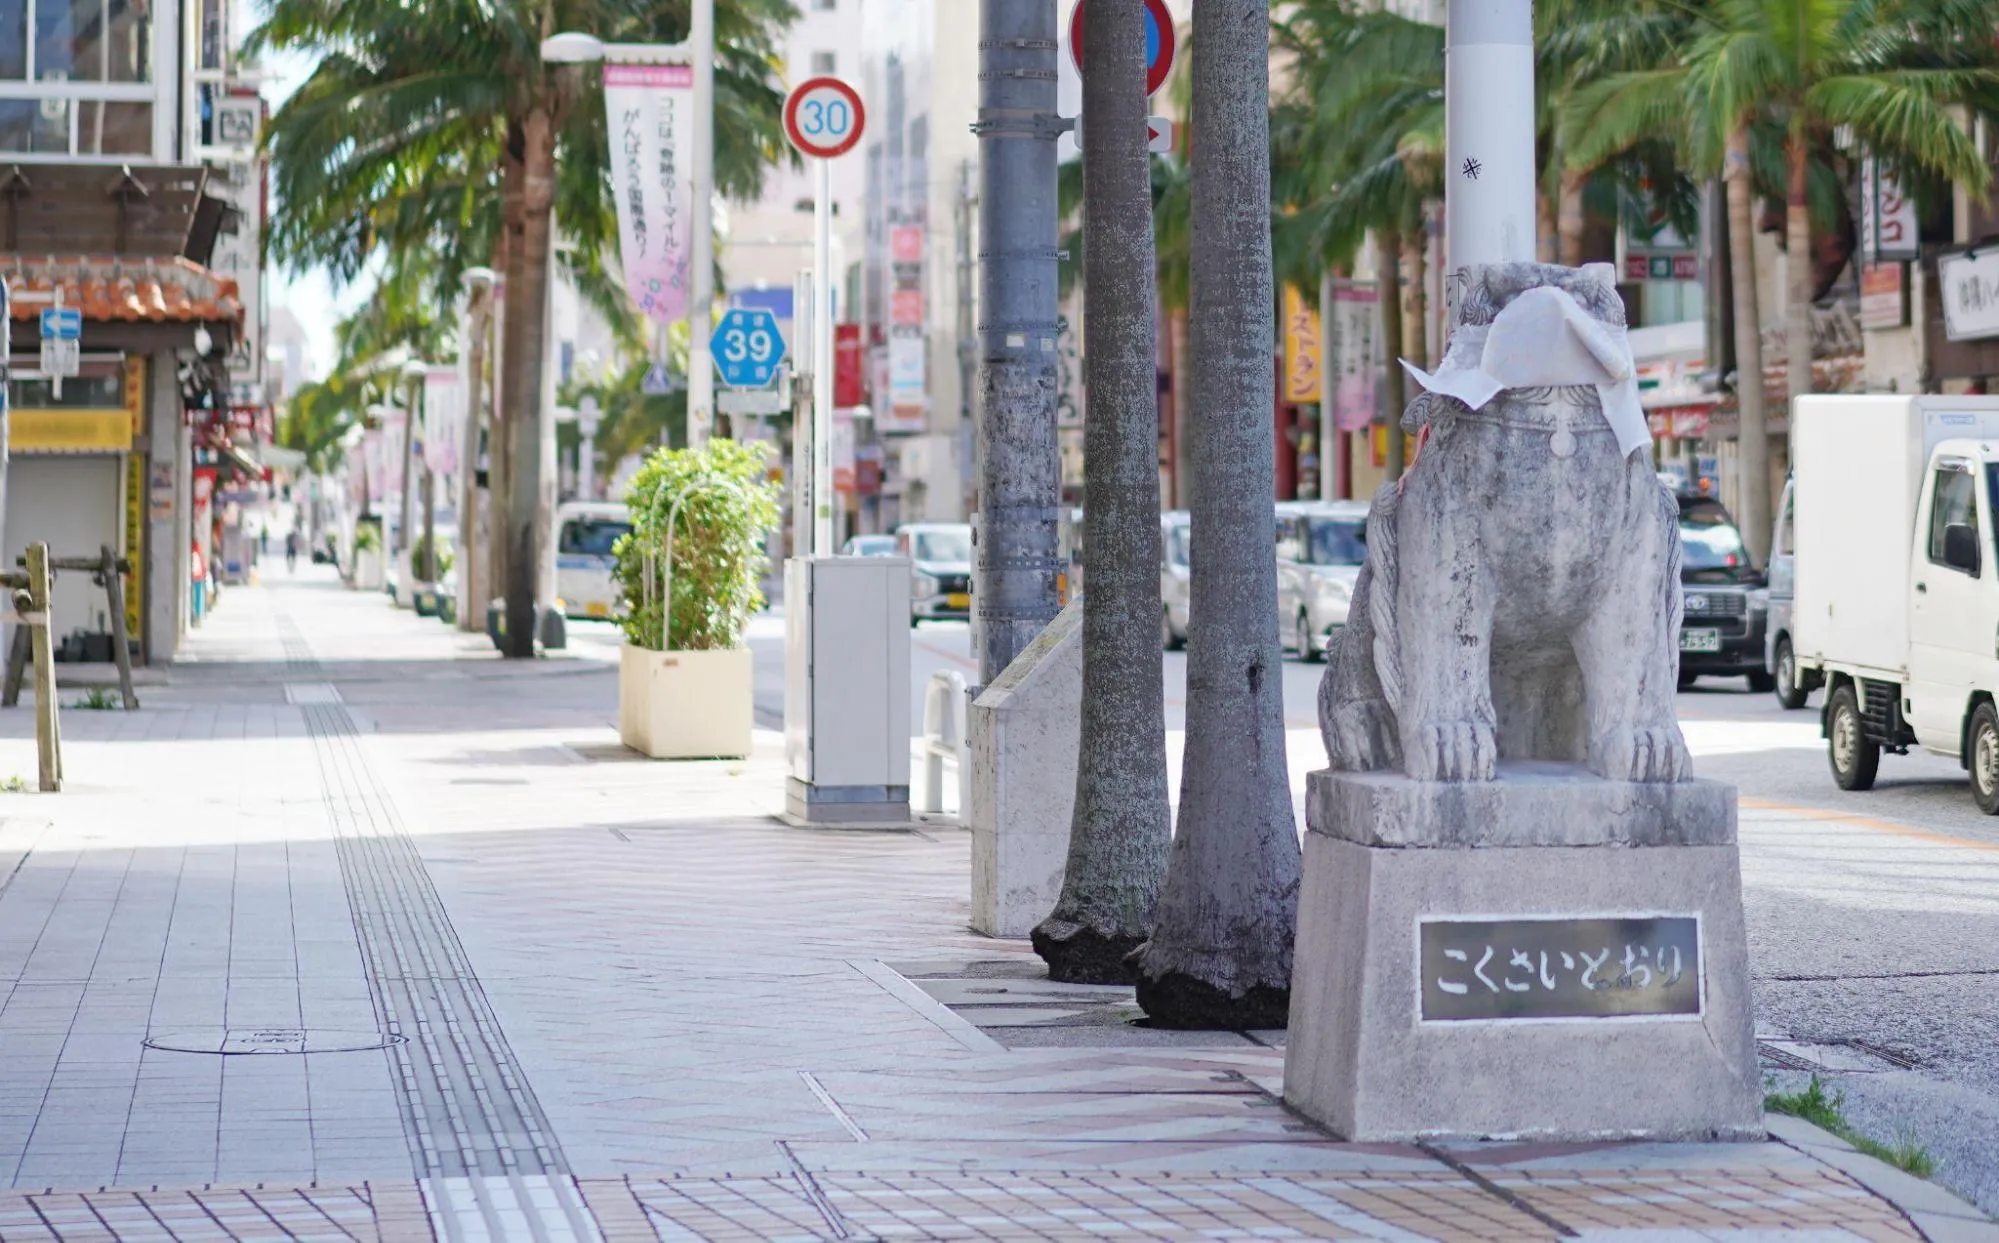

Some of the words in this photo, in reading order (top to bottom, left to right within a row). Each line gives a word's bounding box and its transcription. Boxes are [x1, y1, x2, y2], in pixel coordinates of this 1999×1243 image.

[804, 99, 847, 135] 30
[724, 328, 772, 363] 39
[1437, 944, 1682, 994] こくさいとおり
